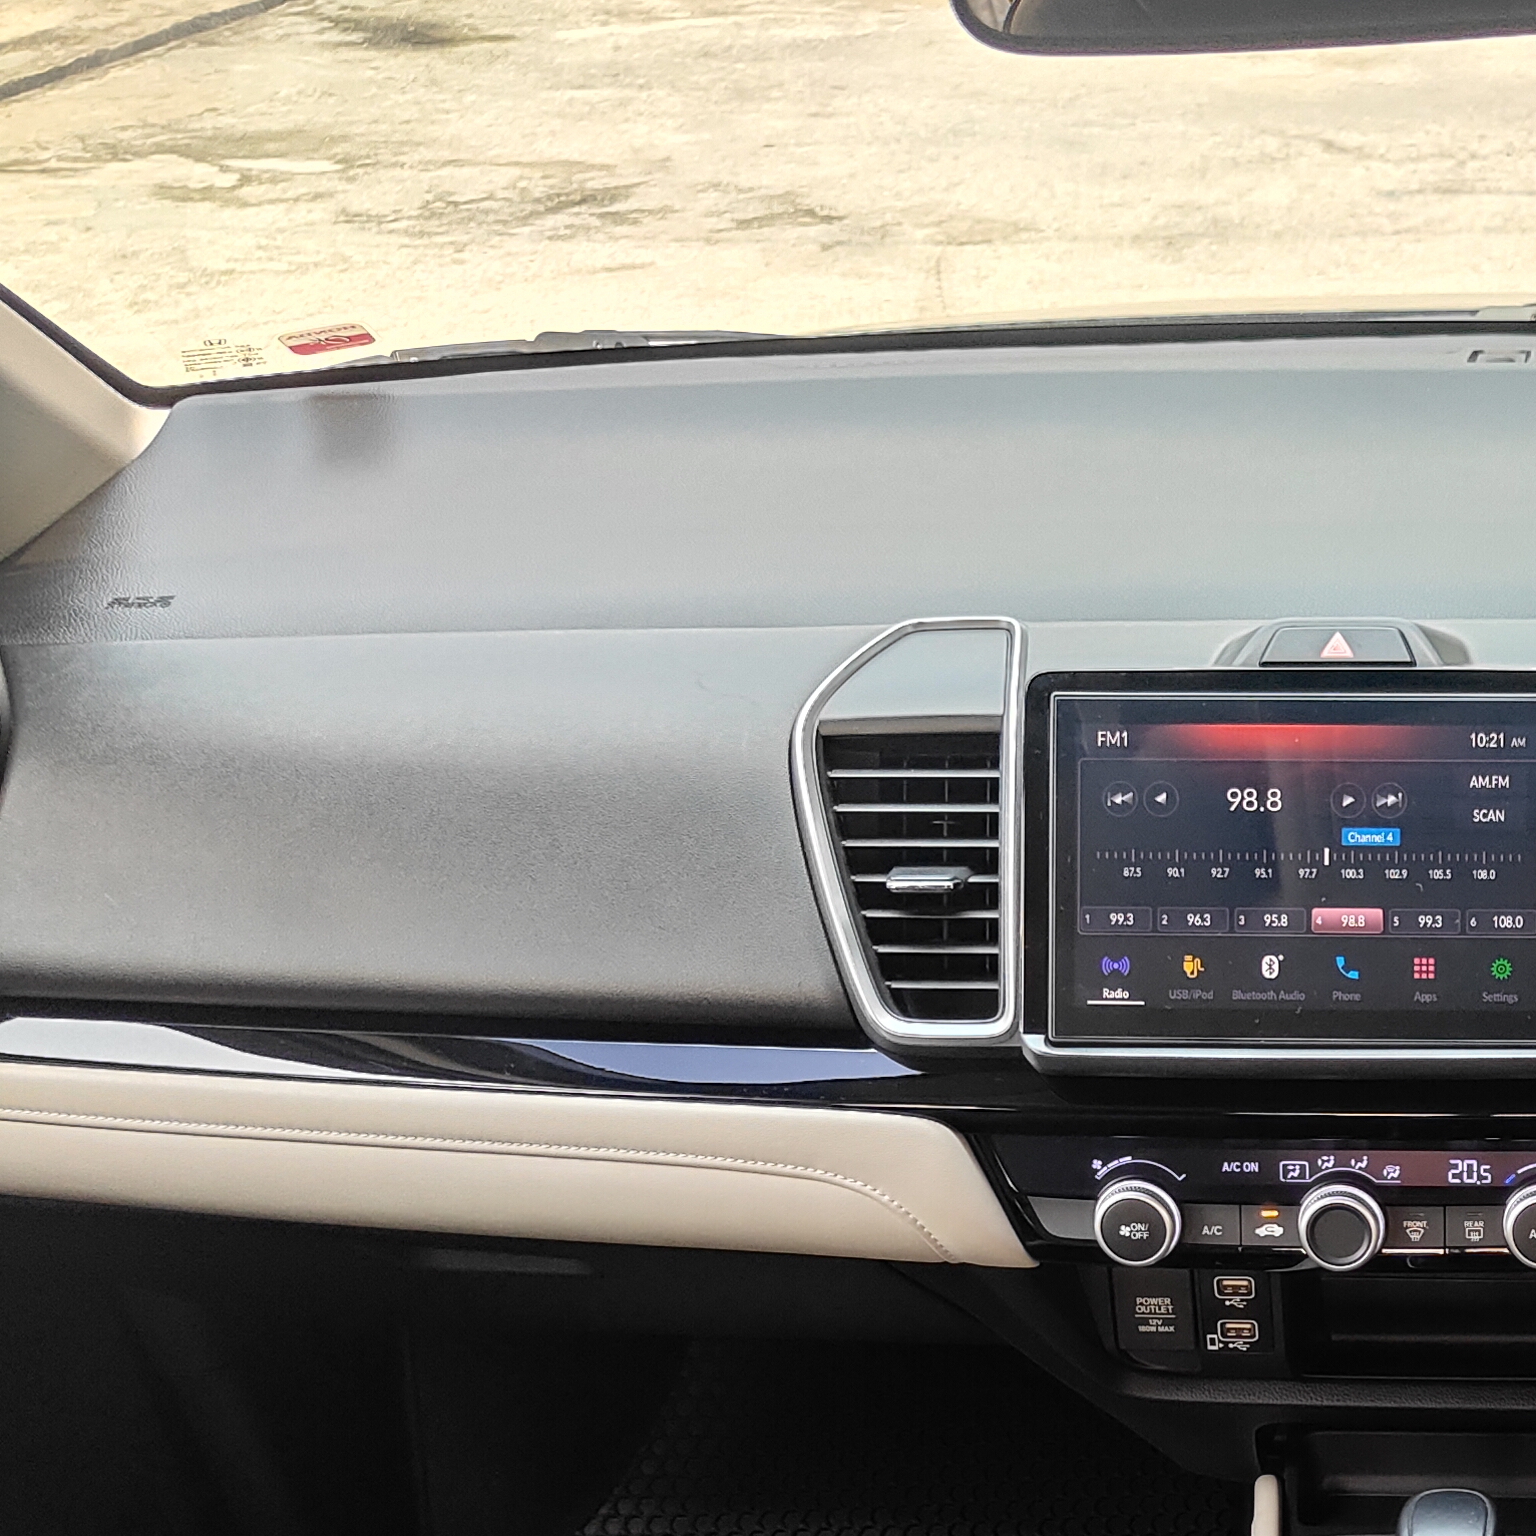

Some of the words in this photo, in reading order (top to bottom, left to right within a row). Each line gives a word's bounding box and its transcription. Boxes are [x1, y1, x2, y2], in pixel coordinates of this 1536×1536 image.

[1097, 731, 1128, 747] FM1
[1469, 732, 1504, 748] 10:21
[1510, 737, 1526, 748] AM
[1226, 787, 1282, 812] 98.8
[1472, 809, 1505, 823] SCAN
[1347, 832, 1386, 843] Channel
[1386, 832, 1394, 842] 4
[1122, 867, 1142, 878] 87.5
[1166, 867, 1185, 878] 90.1
[1210, 867, 1230, 879] 92.7
[1254, 868, 1273, 879] 95.1
[1298, 868, 1318, 879] 97.7
[1340, 869, 1364, 879] 100.3
[1384, 869, 1408, 880] 102.9
[1428, 869, 1452, 880] 105.5
[1472, 869, 1496, 880] 108.0
[1084, 914, 1090, 924] 1
[1109, 913, 1134, 926] 99.3
[1161, 914, 1168, 925] 2
[1186, 913, 1211, 926] 96.3
[1238, 915, 1246, 926] 3
[1263, 913, 1289, 927] 95.8
[1315, 916, 1322, 926] 4
[1340, 914, 1366, 928] 98.8
[1393, 916, 1400, 926] 5
[1418, 915, 1443, 928] 99.3
[1470, 917, 1477, 927] 6
[1492, 915, 1524, 928] 108.0
[1102, 987, 1130, 1000] Radio
[1168, 989, 1214, 1000] USB/iPod
[1232, 990, 1277, 1000] Bluetooth
[1278, 990, 1306, 1001] Audio
[1332, 991, 1362, 1001] Phone
[1414, 991, 1438, 1004] Apps
[1482, 992, 1519, 1004] Settings
[1222, 1162, 1241, 1173] A/C
[1243, 1162, 1259, 1173] ON
[1447, 1159, 1492, 1185] 20.5
[1130, 1223, 1149, 1232] ON/
[1403, 1220, 1428, 1228] FRONT
[1464, 1220, 1485, 1228] REAR
[1130, 1231, 1150, 1240] OFF
[1201, 1226, 1223, 1236] A/C
[1136, 1297, 1171, 1306] POWER
[1135, 1305, 1174, 1314] OUTLET
